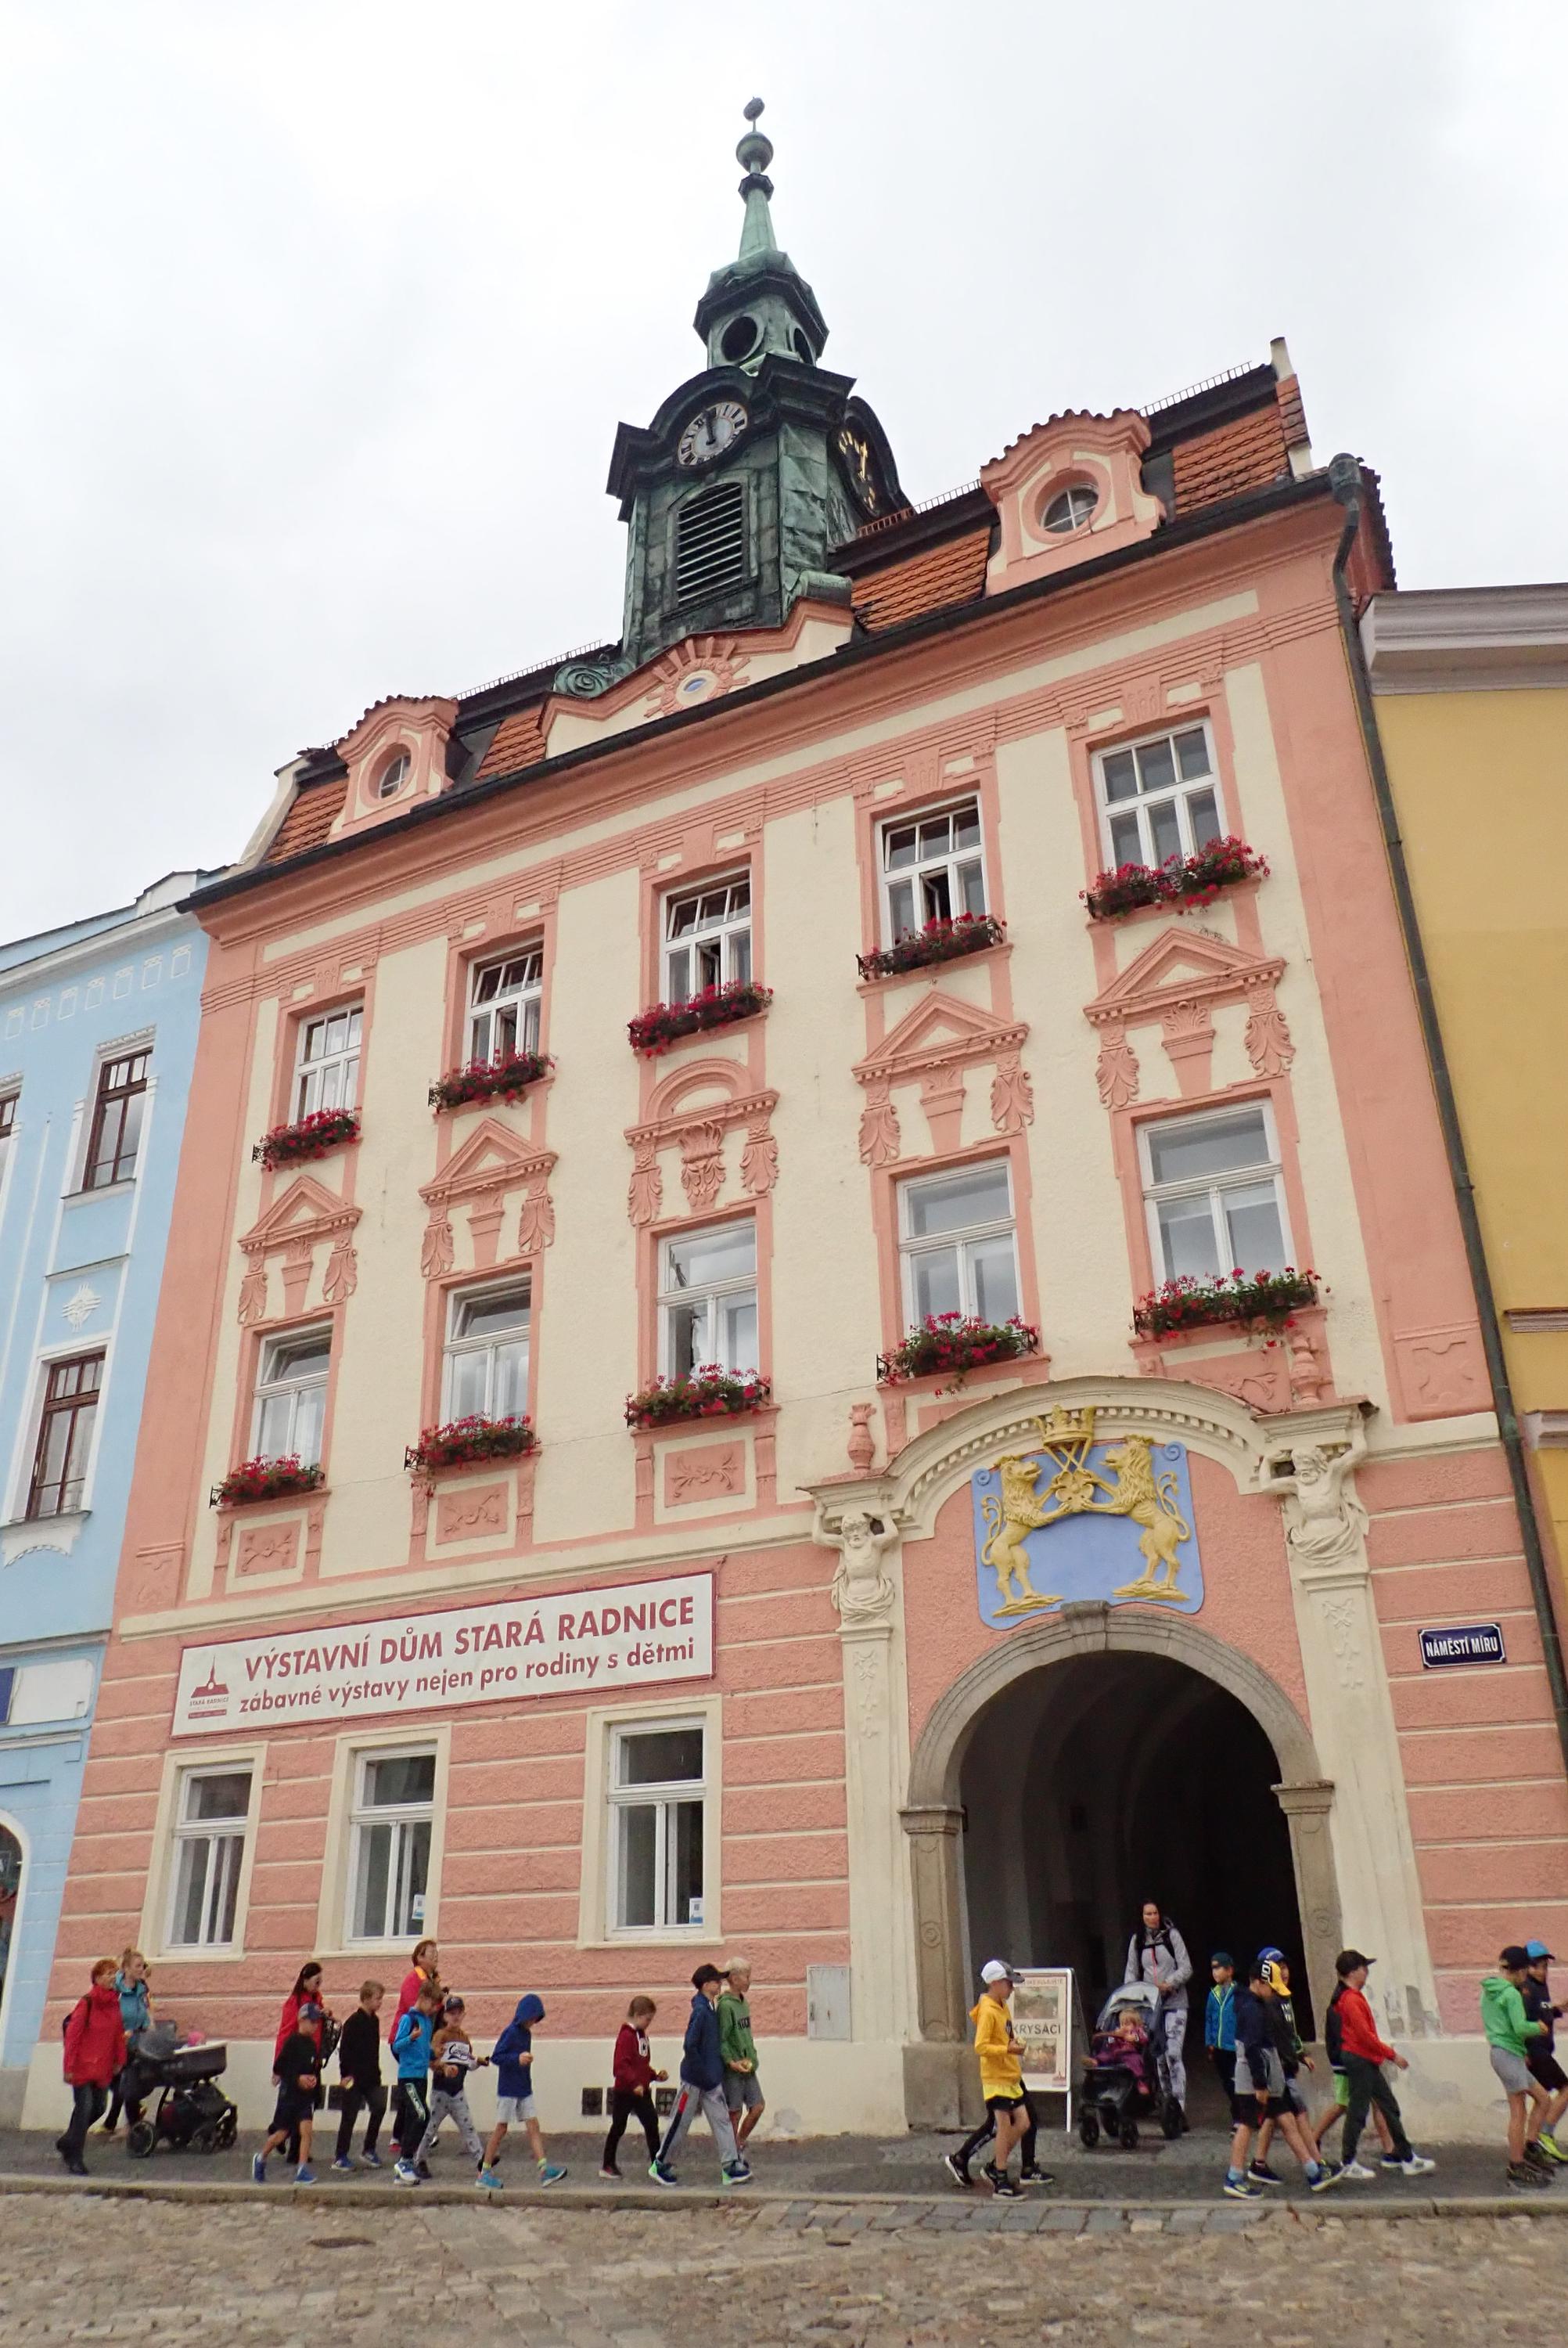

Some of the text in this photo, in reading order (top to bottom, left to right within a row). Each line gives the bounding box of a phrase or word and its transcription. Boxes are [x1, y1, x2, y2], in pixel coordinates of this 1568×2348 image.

[239, 1637, 694, 1712] zábavné výstavy nejen pro rodiny s dětmi
[245, 1596, 694, 1681] VÝSTAVNÍ DŮM STARÁ RADNICE
[1426, 1635, 1498, 1657] NÁMĚSTÍ MÍRU
